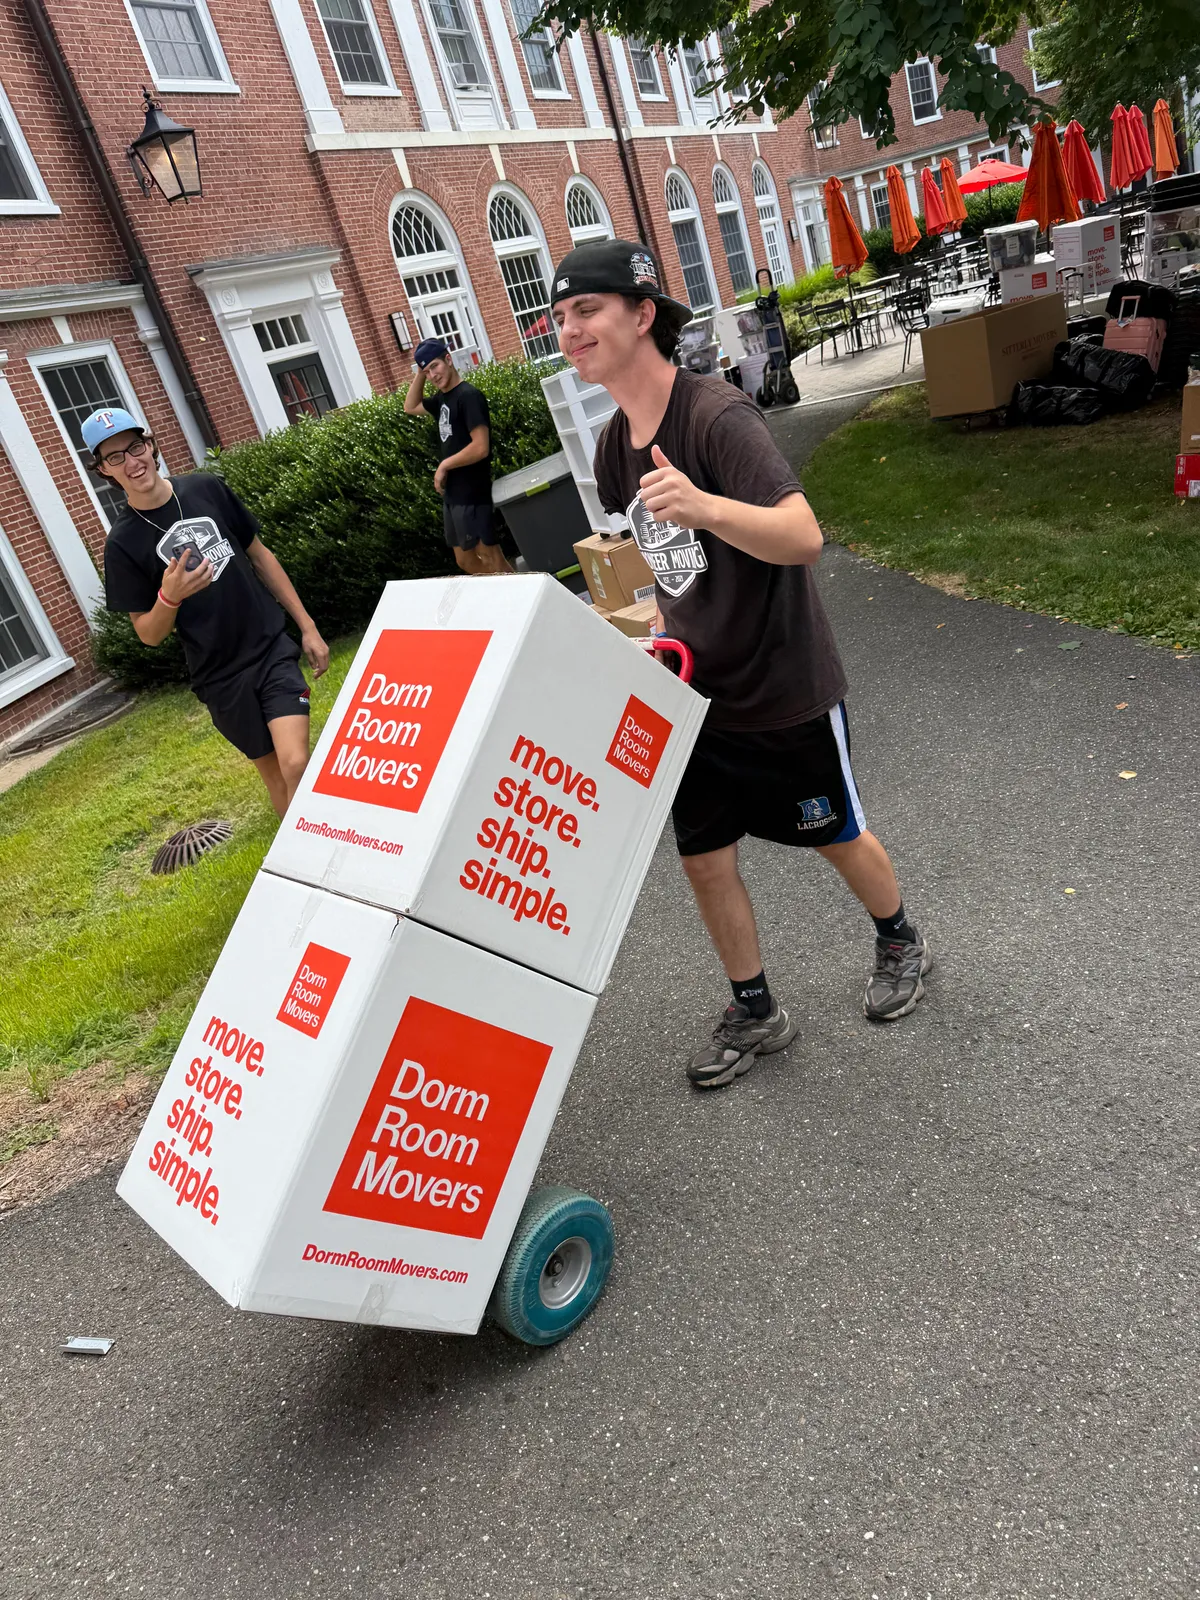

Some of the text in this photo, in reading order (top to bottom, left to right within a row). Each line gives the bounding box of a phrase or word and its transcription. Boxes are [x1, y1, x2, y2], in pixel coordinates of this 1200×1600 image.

[1087, 246, 1108, 257] move.
[1087, 261, 1104, 271] sip.
[95, 411, 115, 430] T
[361, 673, 432, 709] Dorm
[346, 707, 422, 748] Room
[618, 730, 650, 761] Room
[624, 715, 655, 746] Dorm
[330, 743, 421, 790] Movers
[510, 734, 601, 813] move.
[613, 744, 651, 779] Movers
[493, 776, 582, 849] store.
[796, 812, 837, 831] LACROSSE
[295, 816, 404, 856] DormRoomMovers.com
[476, 816, 552, 879] ship.
[459, 858, 571, 936] simple.
[290, 981, 322, 1008] Room
[299, 963, 328, 990] Dorm
[283, 997, 320, 1028] Movers
[202, 1015, 265, 1077] move.
[184, 1055, 243, 1121] store.
[390, 1059, 490, 1122] Dorm
[166, 1096, 213, 1158] ship.
[371, 1104, 480, 1166] Room
[148, 1140, 220, 1226] simple.
[351, 1150, 484, 1213] Movers
[301, 1243, 469, 1285] DormRoomMovers.com
